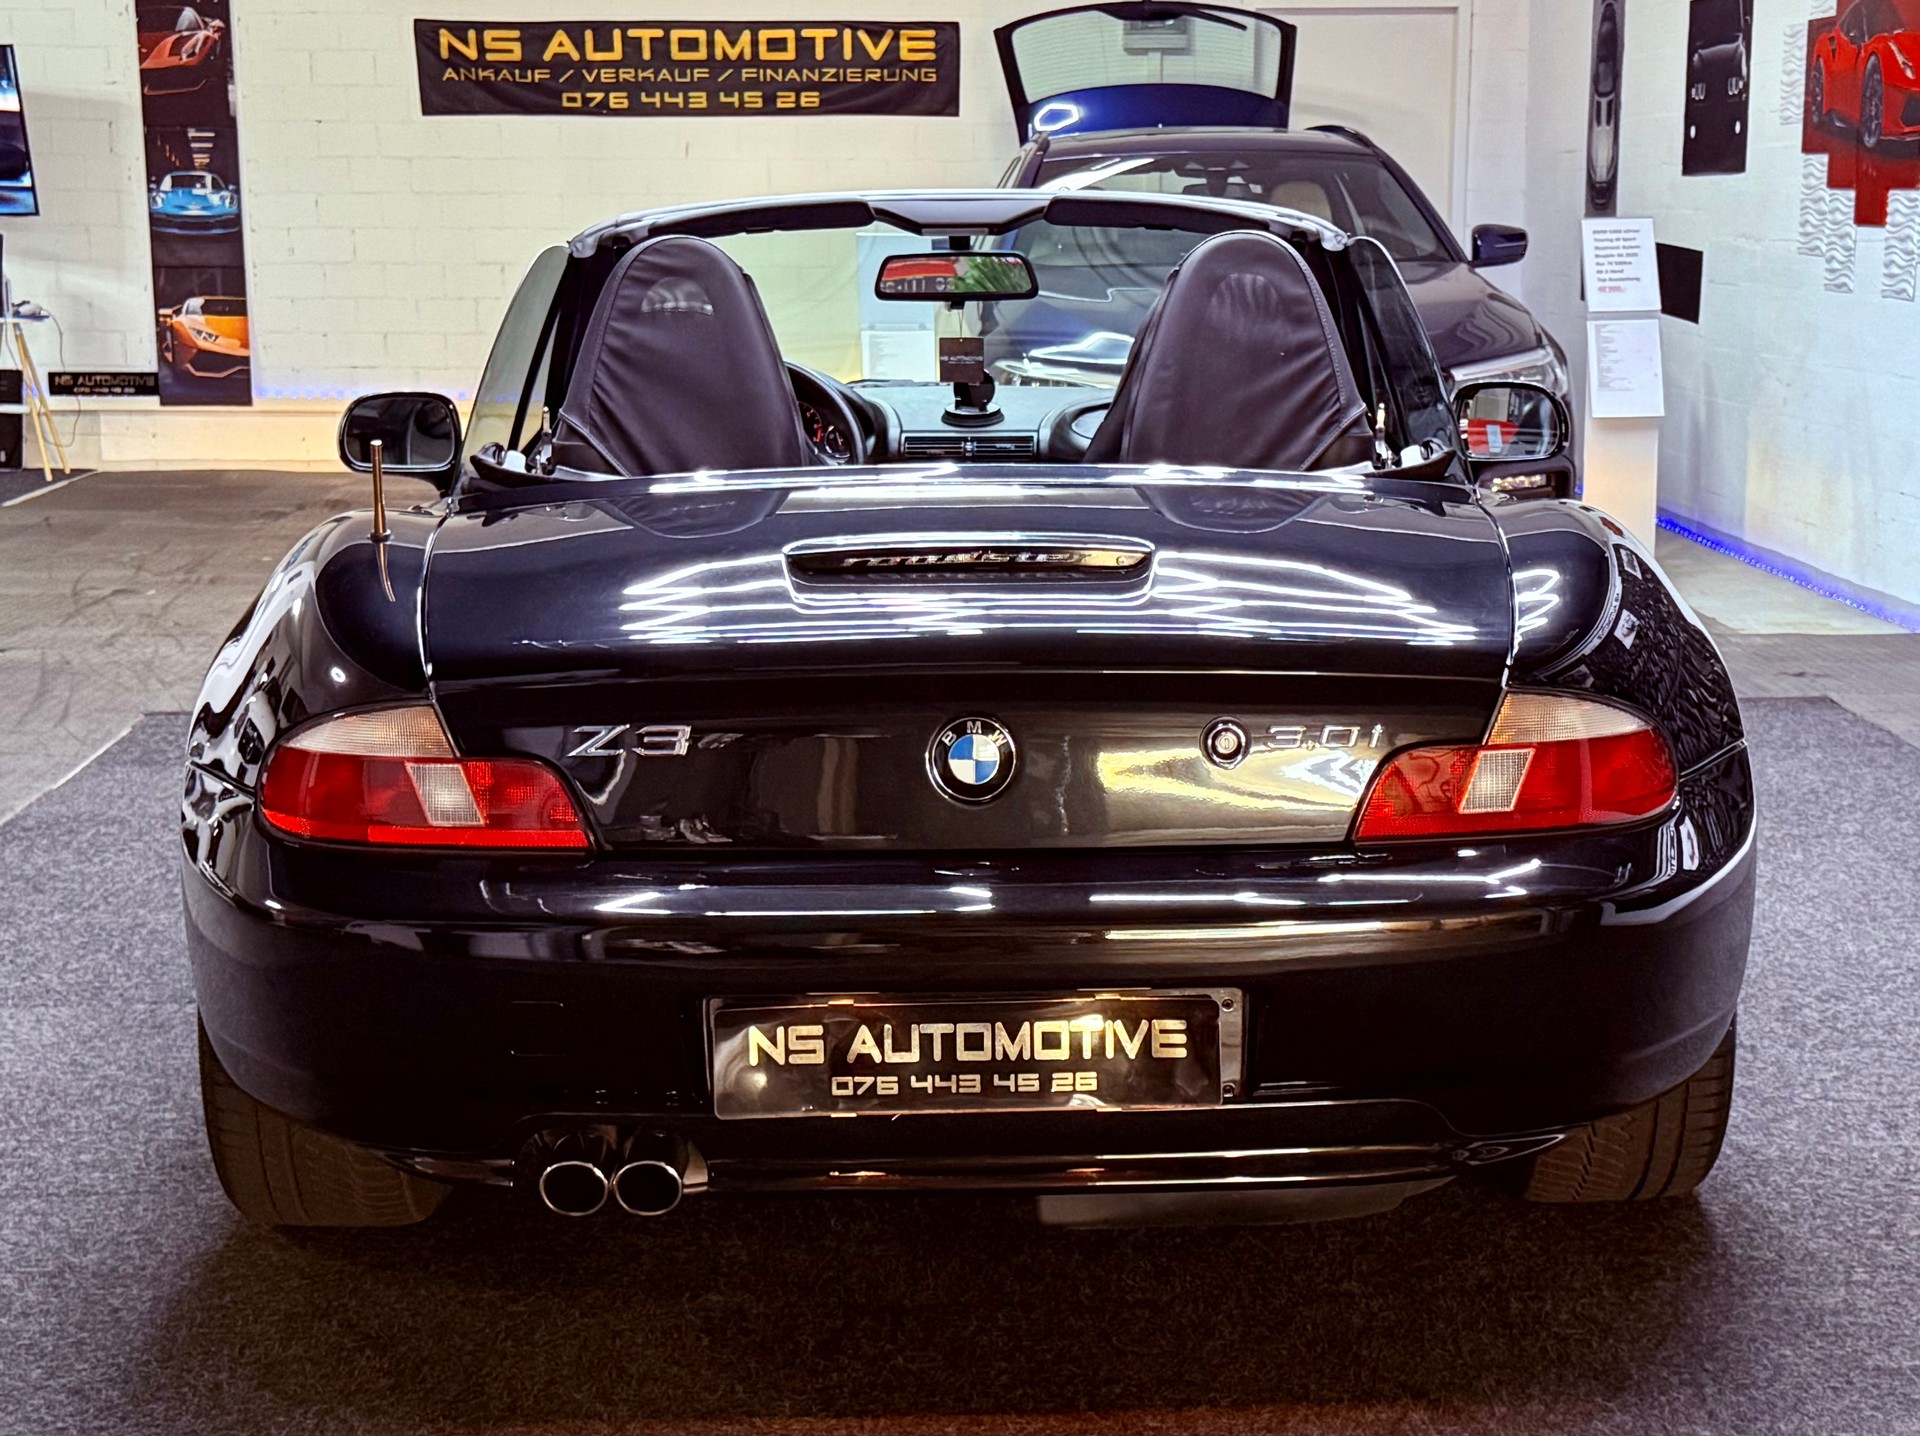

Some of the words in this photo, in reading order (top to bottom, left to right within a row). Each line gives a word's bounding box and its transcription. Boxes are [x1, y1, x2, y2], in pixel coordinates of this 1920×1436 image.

[438, 28, 522, 62] NS
[542, 28, 938, 62] AUTOMOTIVE
[441, 67, 551, 84] ANKAUF
[581, 67, 710, 83] VERKAUF
[740, 67, 938, 83] FINANZIERUNG
[561, 91, 629, 109] 076
[640, 91, 708, 109] 443
[719, 91, 764, 108] 45
[775, 91, 821, 108] 26
[566, 724, 692, 757] Z3
[941, 720, 1009, 747] BMW
[1264, 723, 1385, 751] 3.0i
[747, 1023, 825, 1067] NS
[846, 1019, 1188, 1065] AUTOMOTIVE
[831, 1075, 899, 1096] 076
[910, 1074, 982, 1094] 443
[992, 1072, 1040, 1093] 45
[1050, 1071, 1098, 1092] 26
